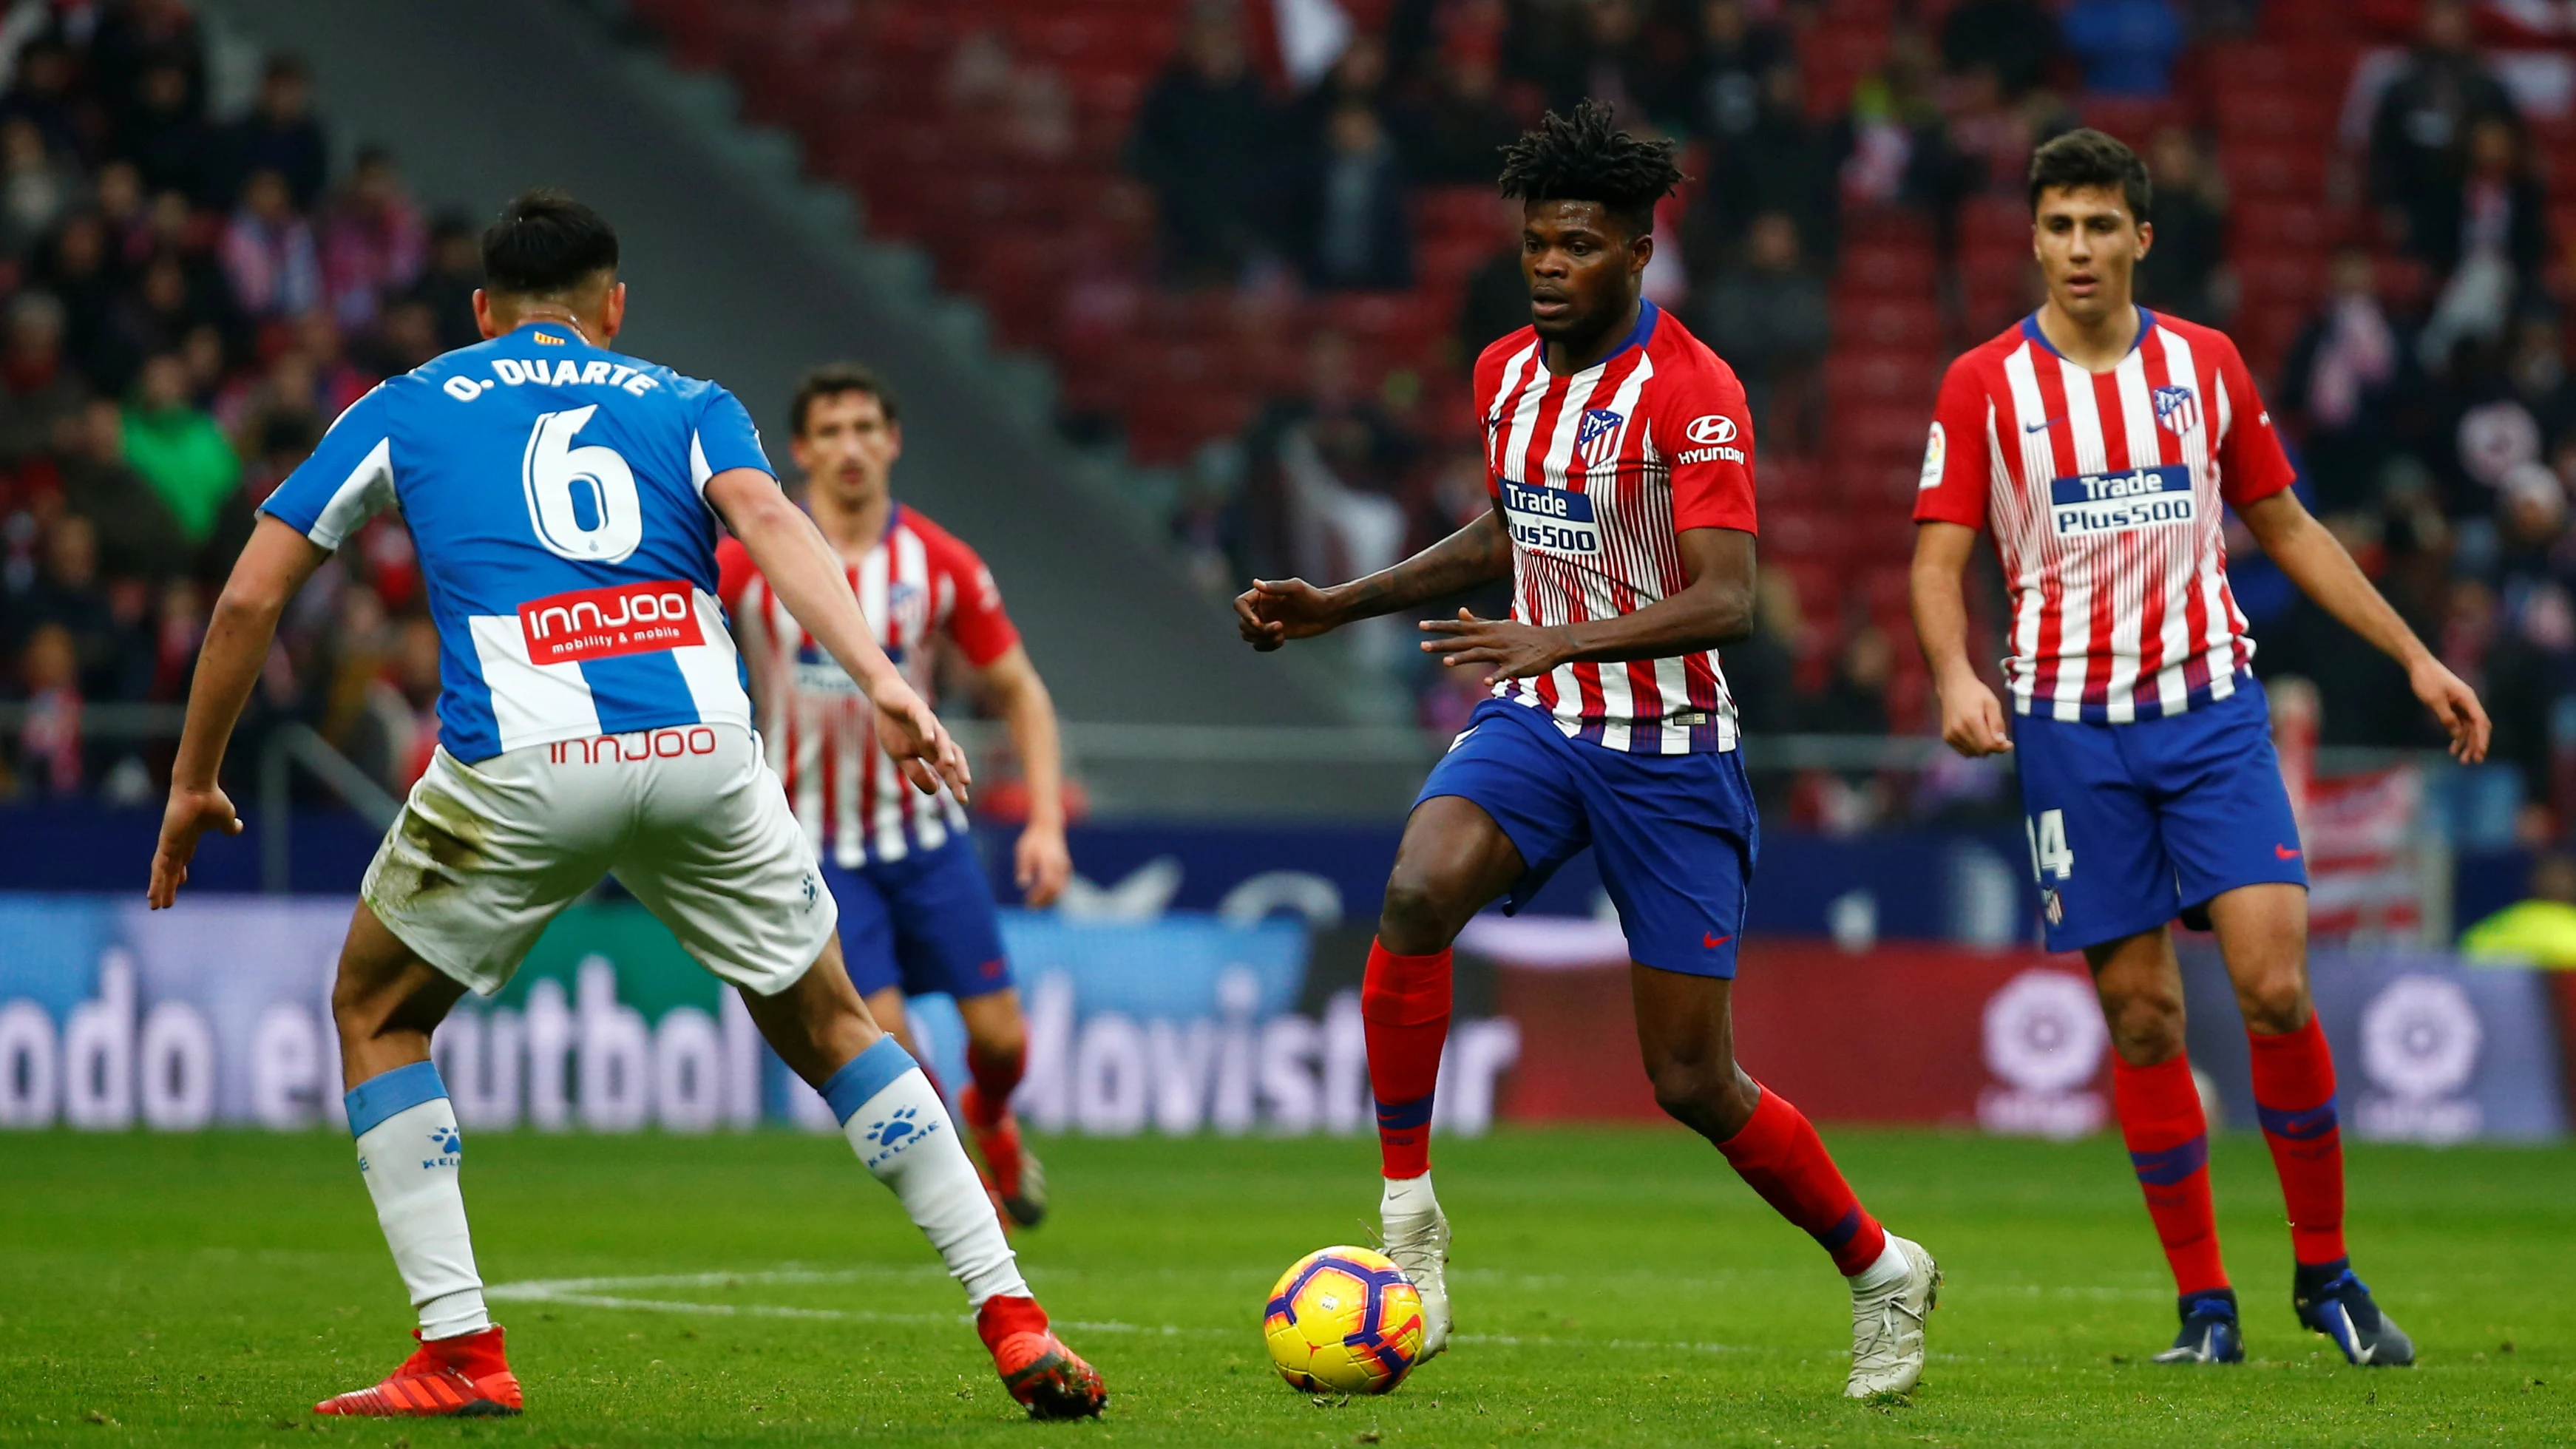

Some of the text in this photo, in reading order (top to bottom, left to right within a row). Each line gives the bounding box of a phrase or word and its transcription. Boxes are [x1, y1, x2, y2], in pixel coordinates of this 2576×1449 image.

[443, 358, 660, 402] O. DUARTE
[1677, 446, 1745, 466] HYUNDAI
[521, 404, 643, 566] 6
[1505, 483, 1567, 517] Trade
[2080, 469, 2163, 500] Trade
[1509, 516, 1597, 552] lus500
[2058, 500, 2191, 534] Plus500
[552, 626, 680, 654] mobility & mobile
[427, 952, 762, 1133] utbol
[867, 1120, 940, 1168] KELME
